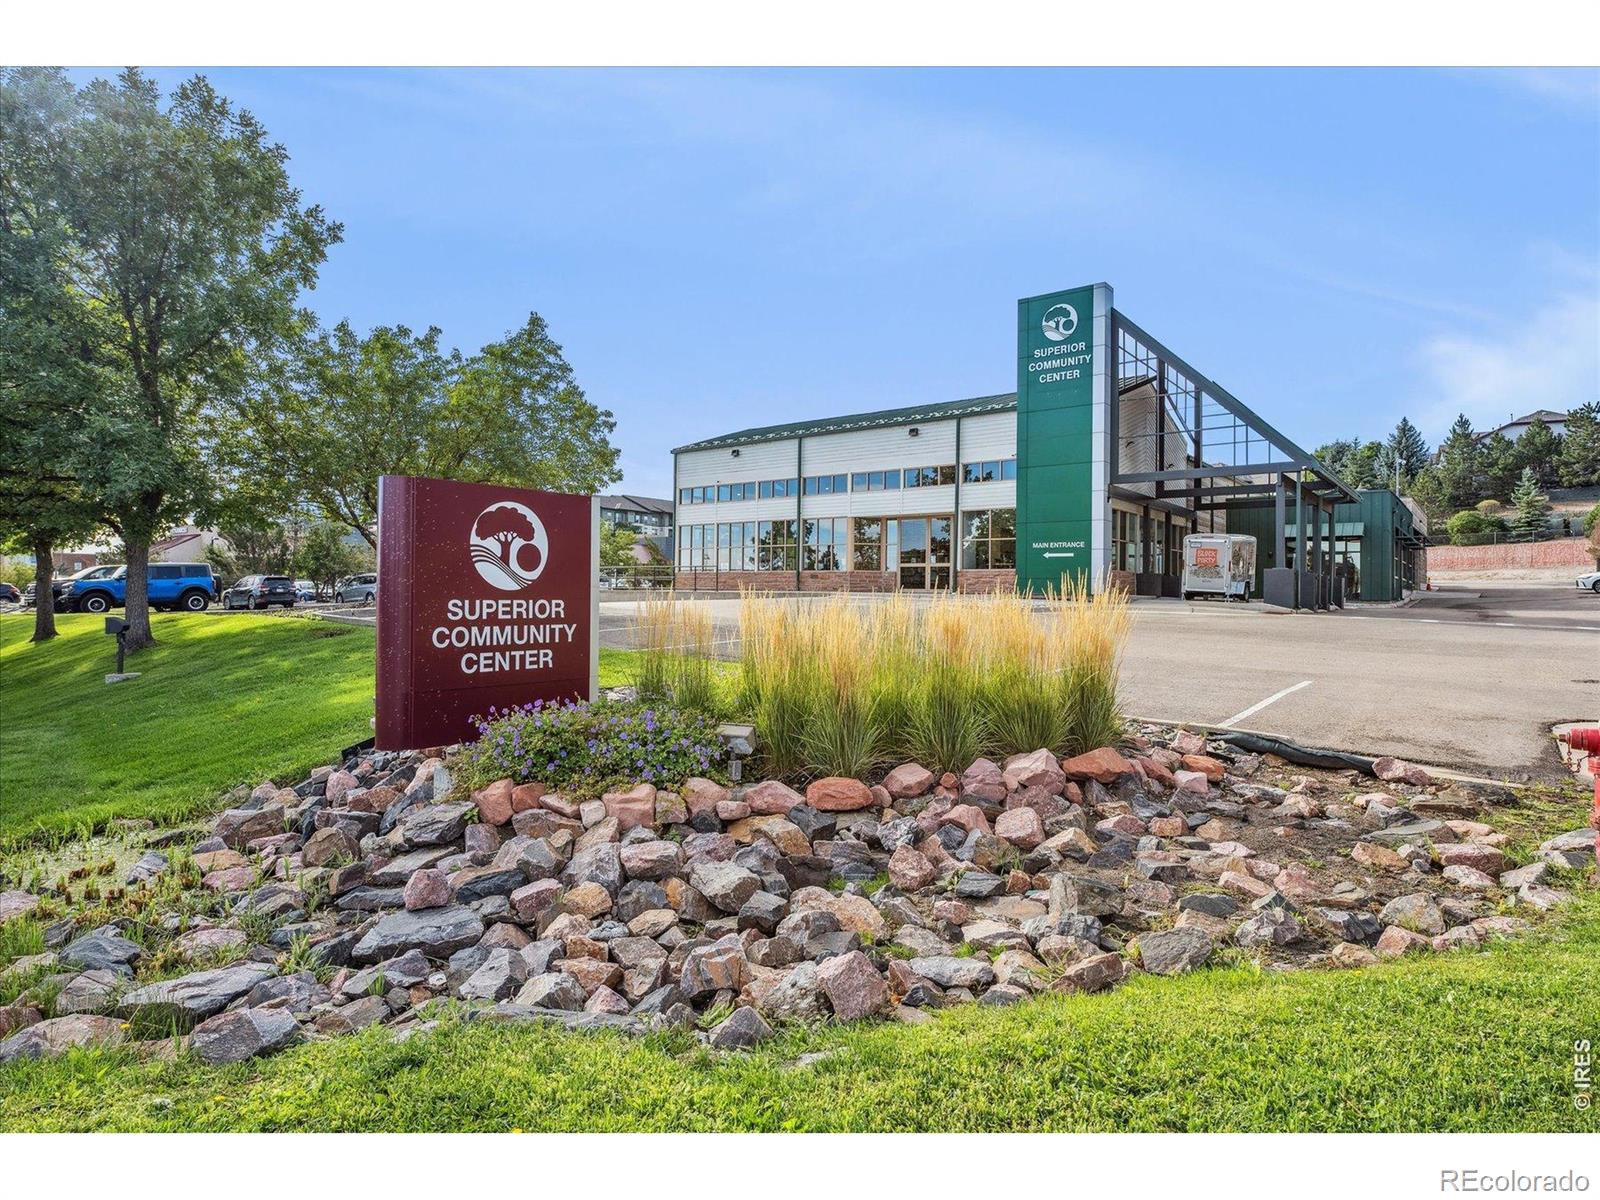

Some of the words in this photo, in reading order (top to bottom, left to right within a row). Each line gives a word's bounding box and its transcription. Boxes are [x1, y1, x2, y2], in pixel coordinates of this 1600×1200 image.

[1033, 342, 1086, 358] SUPERIOR
[1028, 354, 1092, 372] COMMUNITY
[1039, 369, 1080, 383] CENTER
[447, 599, 565, 621] SUPERIOR
[432, 623, 577, 649] COMMUNITY
[460, 649, 553, 674] CENTER
